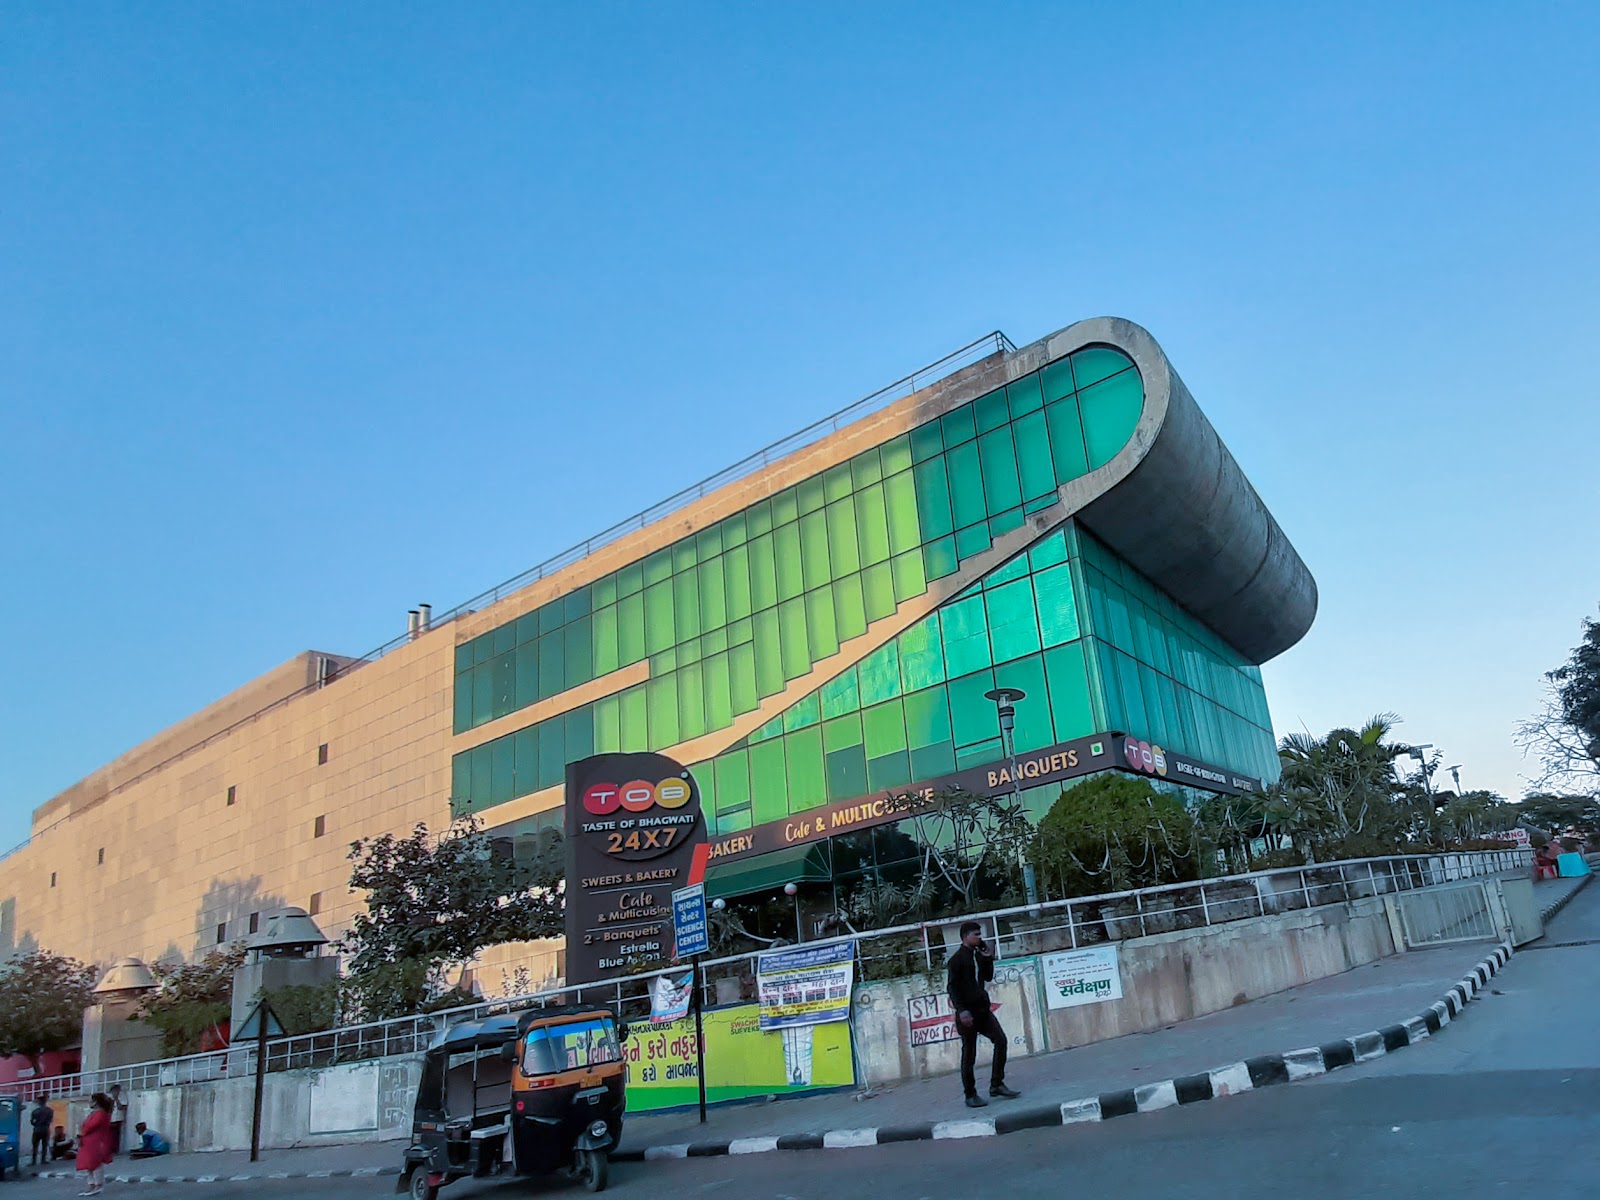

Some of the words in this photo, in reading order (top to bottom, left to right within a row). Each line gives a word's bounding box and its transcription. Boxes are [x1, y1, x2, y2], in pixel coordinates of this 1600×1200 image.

[1128, 745, 1165, 768] TOB
[987, 749, 1079, 788] BANQUETS
[591, 786, 685, 805] TOB
[582, 820, 617, 832] TASTE
[620, 818, 635, 829] OF
[638, 814, 695, 828] BHAGWATI
[785, 823, 810, 843] Cafe
[815, 816, 826, 832] &
[831, 787, 935, 828] MULTICUISNE
[607, 828, 678, 853] 24X7
[581, 875, 623, 888] SWEETS
[625, 873, 634, 883] &
[636, 868, 678, 882] BAKERY
[619, 892, 653, 910] Cafe
[598, 913, 607, 923] &
[583, 934, 593, 945] 2
[603, 925, 659, 942] Banquets
[677, 920, 705, 937] SCIENCE
[620, 941, 660, 955] Estrella
[678, 932, 705, 947] CENTER
[598, 957, 624, 969] Blue
[1059, 978, 1111, 997] सर्वेक्षण
[943, 1023, 958, 1041] PA
[647, 1033, 667, 1060] કરો
